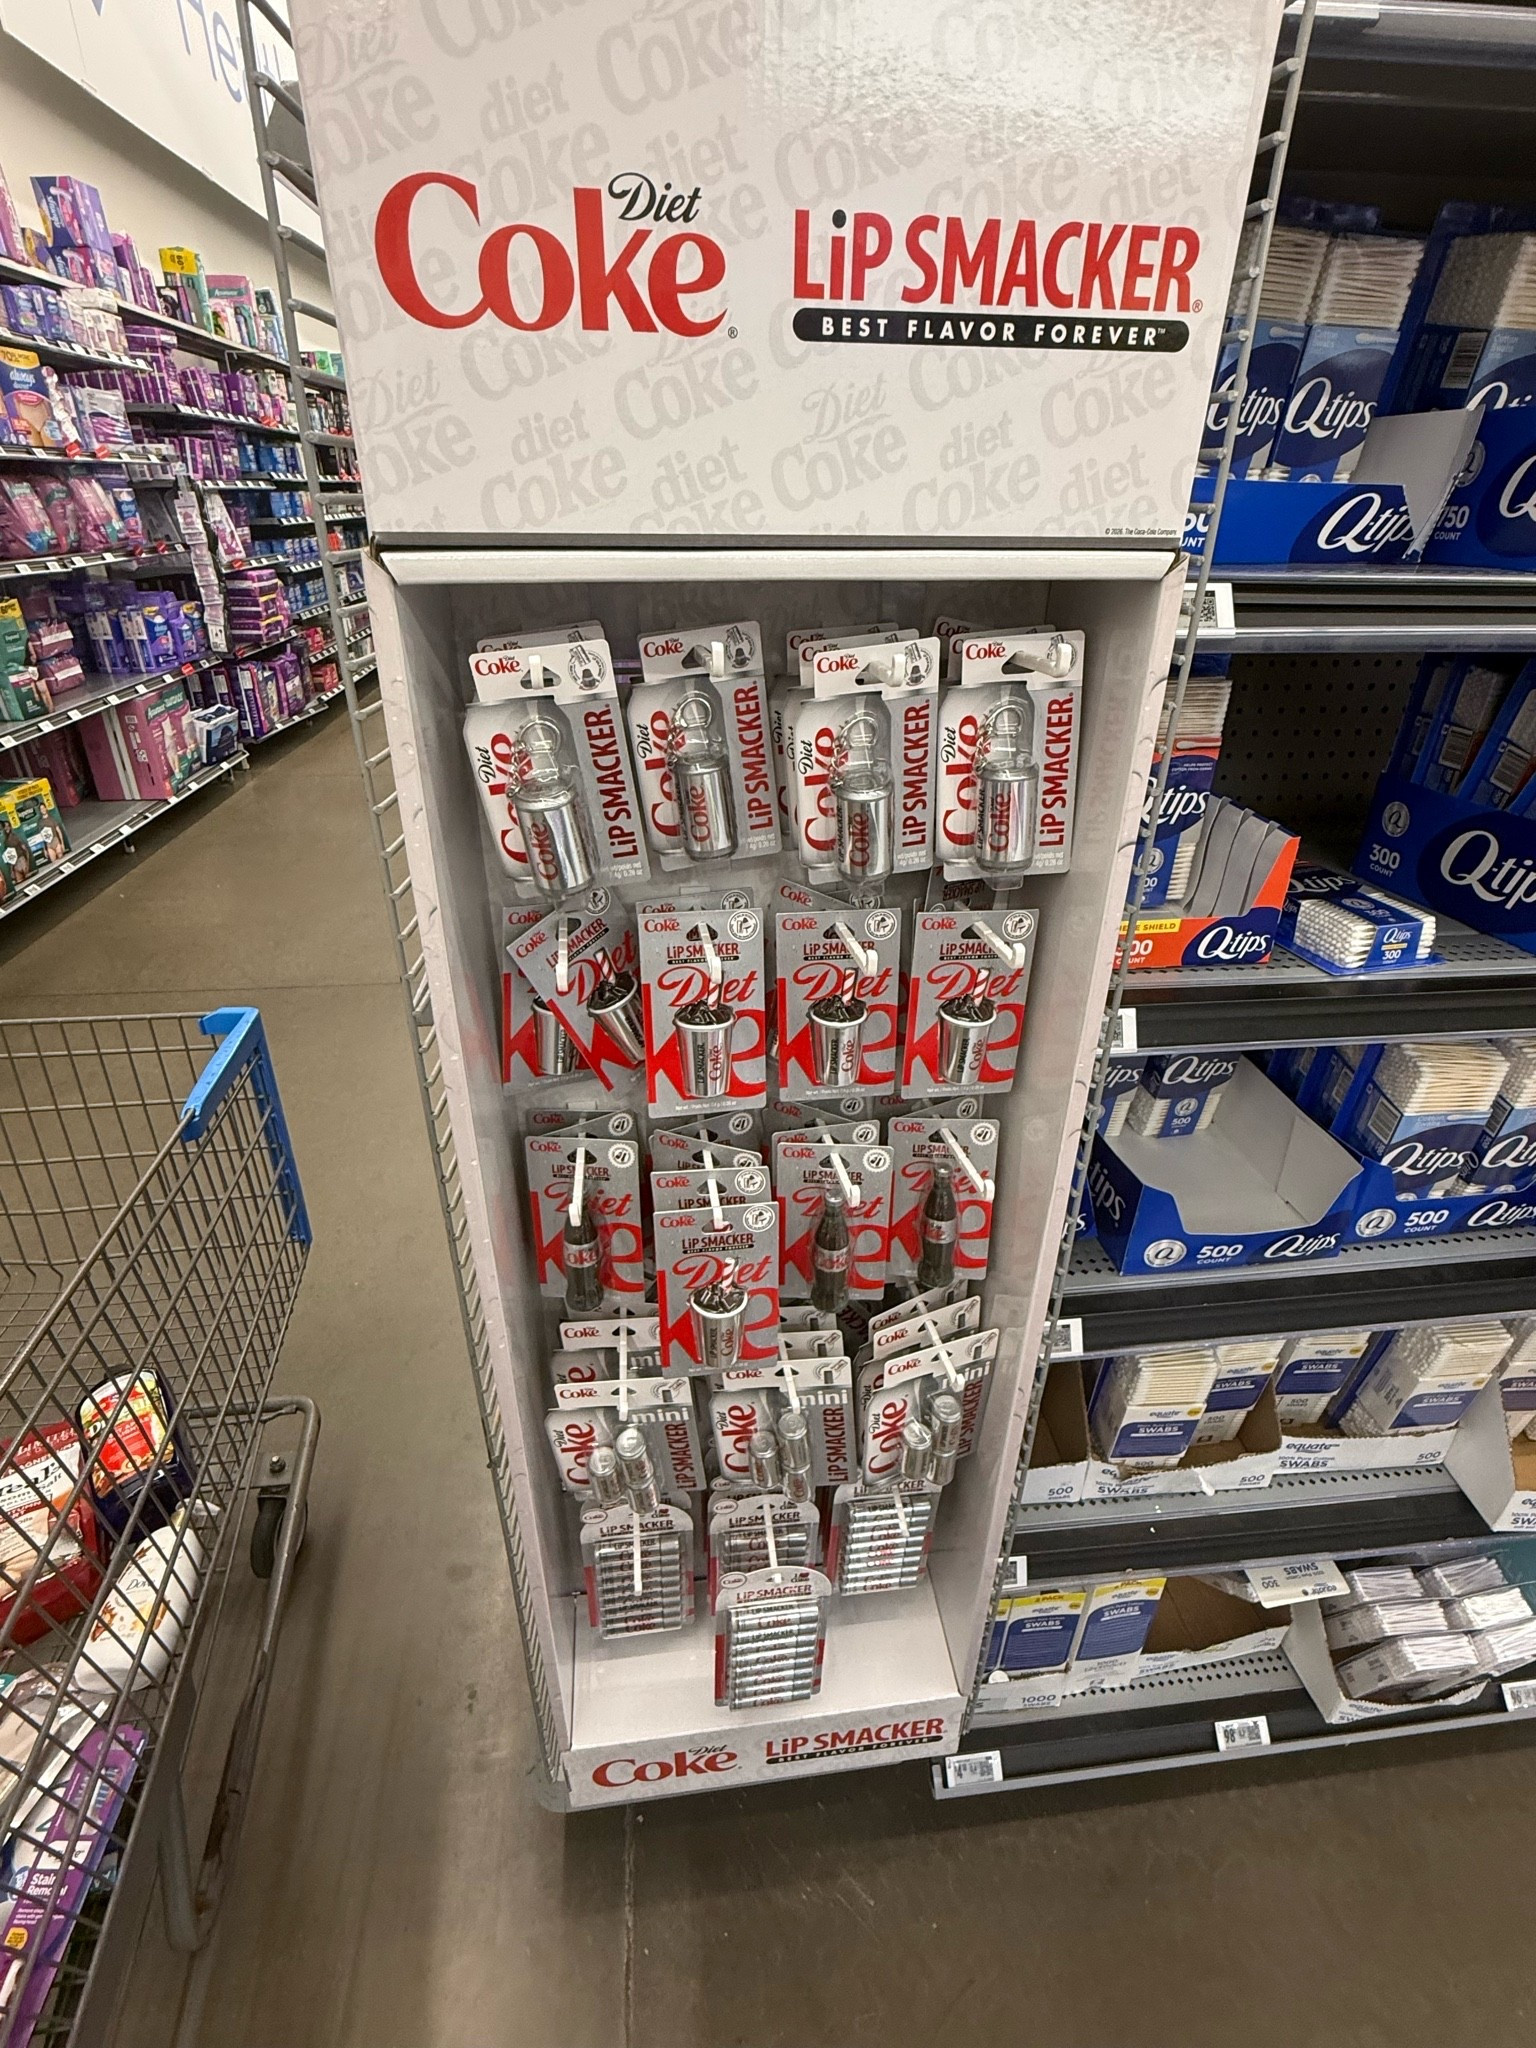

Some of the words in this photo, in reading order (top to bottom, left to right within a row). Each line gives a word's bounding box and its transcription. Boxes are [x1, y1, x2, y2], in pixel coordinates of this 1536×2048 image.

[606, 172, 702, 223] Diet
[374, 172, 728, 337] Coke
[900, 215, 1201, 313] SMACKER
[822, 316, 888, 338] BEST
[907, 319, 1015, 342] FLAVOR
[1284, 376, 1379, 439] Q-tips
[1434, 531, 1462, 541] COUNT
[643, 640, 684, 659] Coke
[966, 642, 1007, 661] Coke
[474, 656, 522, 677] Coke
[816, 655, 859, 675] Coke
[733, 686, 770, 795] SMACKER
[902, 701, 930, 811] SMACKER
[1041, 698, 1074, 809] SMACKER
[583, 709, 633, 822] SMACKER
[988, 793, 1011, 852] Coke
[849, 811, 870, 867] Coke
[1369, 843, 1401, 870] 300
[1369, 863, 1394, 877] COUNT
[1440, 830, 1536, 910] Q-tip
[644, 918, 681, 933] Coke
[782, 918, 818, 931] Coke
[921, 918, 957, 931] Coke
[1143, 922, 1177, 931] SHIELD
[822, 941, 875, 955] SMAER
[1197, 925, 1271, 960] Q-tips
[686, 943, 740, 958] SMKER
[1382, 950, 1402, 960] 300
[1162, 1055, 1239, 1085] Q-tips
[1171, 1116, 1192, 1126] 500
[1380, 1142, 1466, 1176] Q-tips
[1404, 1209, 1450, 1227] 500
[1403, 1225, 1438, 1234] COUNT
[700, 1233, 755, 1247] SMACKER
[1263, 1233, 1341, 1259] Q-tips
[1196, 1244, 1244, 1259] 500
[1196, 1257, 1232, 1265] COUNT
[1215, 1379, 1251, 1389] SWABS
[1422, 1396, 1460, 1404] SWABS
[631, 1407, 690, 1423] mini
[1149, 1410, 1182, 1418] equate
[822, 1406, 848, 1462] SMACKER
[1138, 1425, 1179, 1434] SWABS
[664, 1422, 694, 1469] SMACKER
[1285, 1442, 1335, 1453] equate
[1417, 1451, 1441, 1461] 500
[1279, 1460, 1329, 1468] SWABS
[1240, 1474, 1266, 1483] 500
[1048, 1486, 1074, 1496] 500
[1283, 1562, 1319, 1575] SWABS
[757, 1584, 812, 1598] SMACKER
[1261, 1580, 1281, 1590] 300
[1103, 1606, 1140, 1617] SWABS
[1025, 1620, 1061, 1628] SWABS
[1022, 1694, 1057, 1704] 1000
[813, 1718, 945, 1751] SMACKER
[689, 1743, 728, 1756] Diet
[815, 1746, 865, 1758] FLAVOR
[872, 1737, 929, 1749] FOREVER
[592, 1751, 739, 1788] Coke
